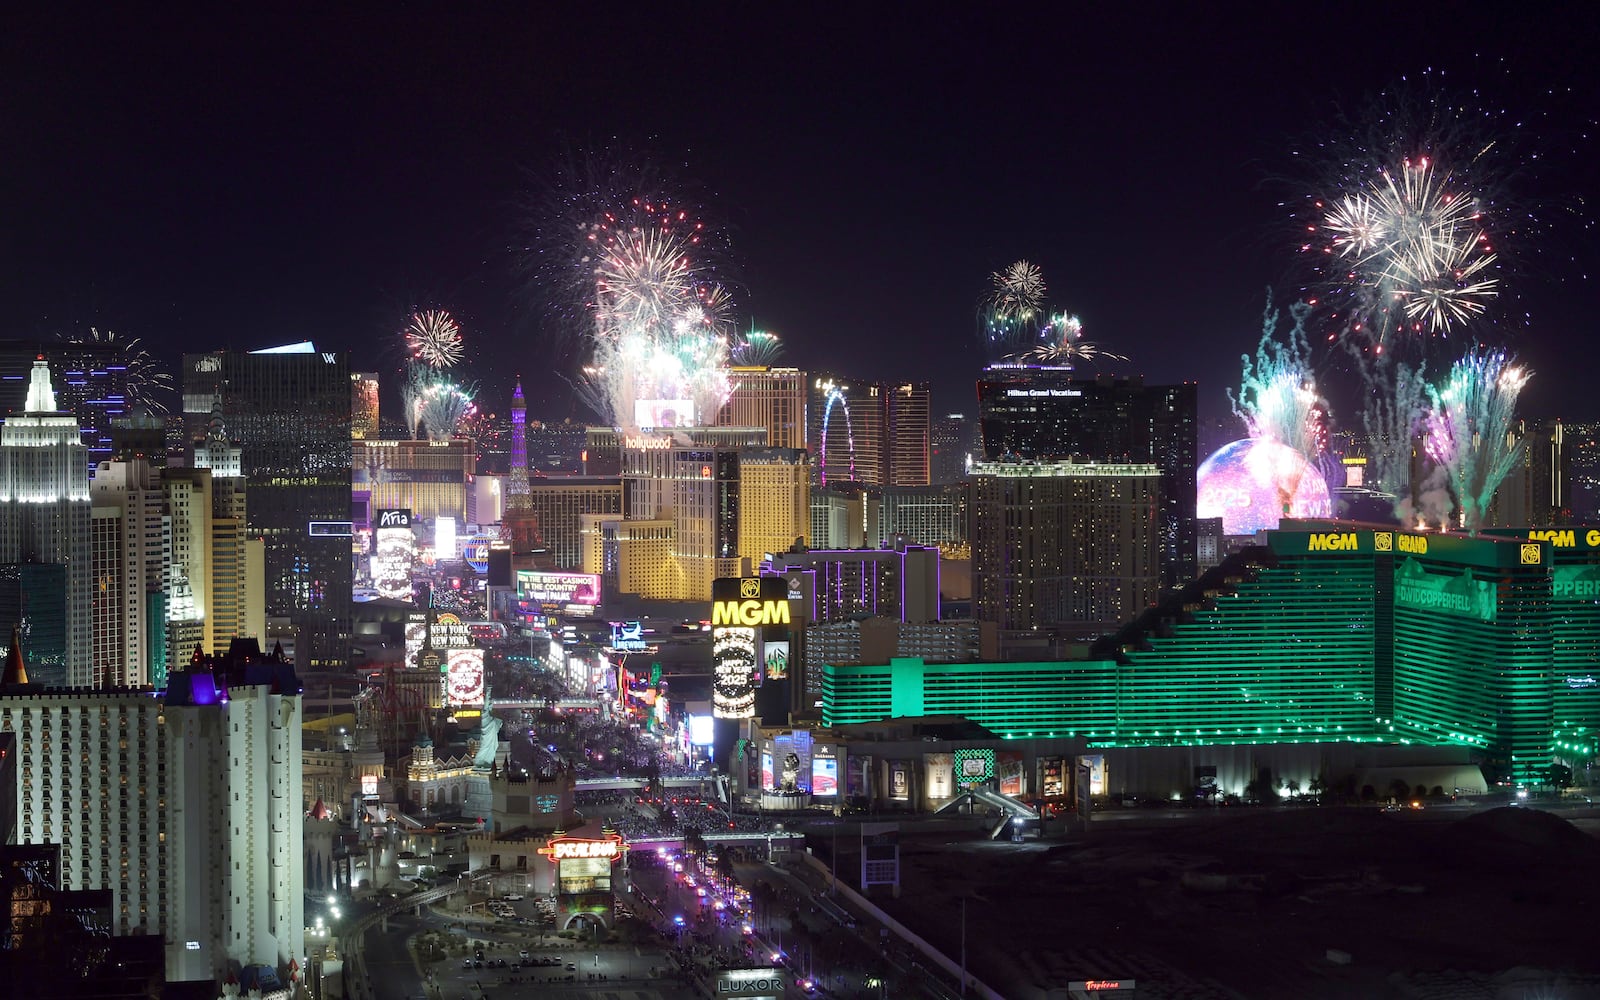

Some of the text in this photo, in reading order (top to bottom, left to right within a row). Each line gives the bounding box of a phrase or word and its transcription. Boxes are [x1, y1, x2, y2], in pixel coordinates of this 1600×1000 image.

[1007, 389, 1082, 397] Hilton Grand Vacations
[626, 436, 670, 453] hollywood
[380, 511, 408, 526] Aria
[1308, 533, 1428, 554] MGM GRAND
[1528, 530, 1576, 547] MGM
[562, 577, 592, 585] CASINOS
[545, 584, 577, 592] COUNTRY
[712, 600, 791, 626] MGM
[430, 625, 448, 634] NEW
[430, 636, 469, 645] NEW YORK
[721, 659, 744, 667] HAPPY
[715, 666, 731, 674] NEW
[721, 674, 747, 685] 2025
[718, 978, 784, 993] LUXOR
[1086, 980, 1119, 991] Tropicana
